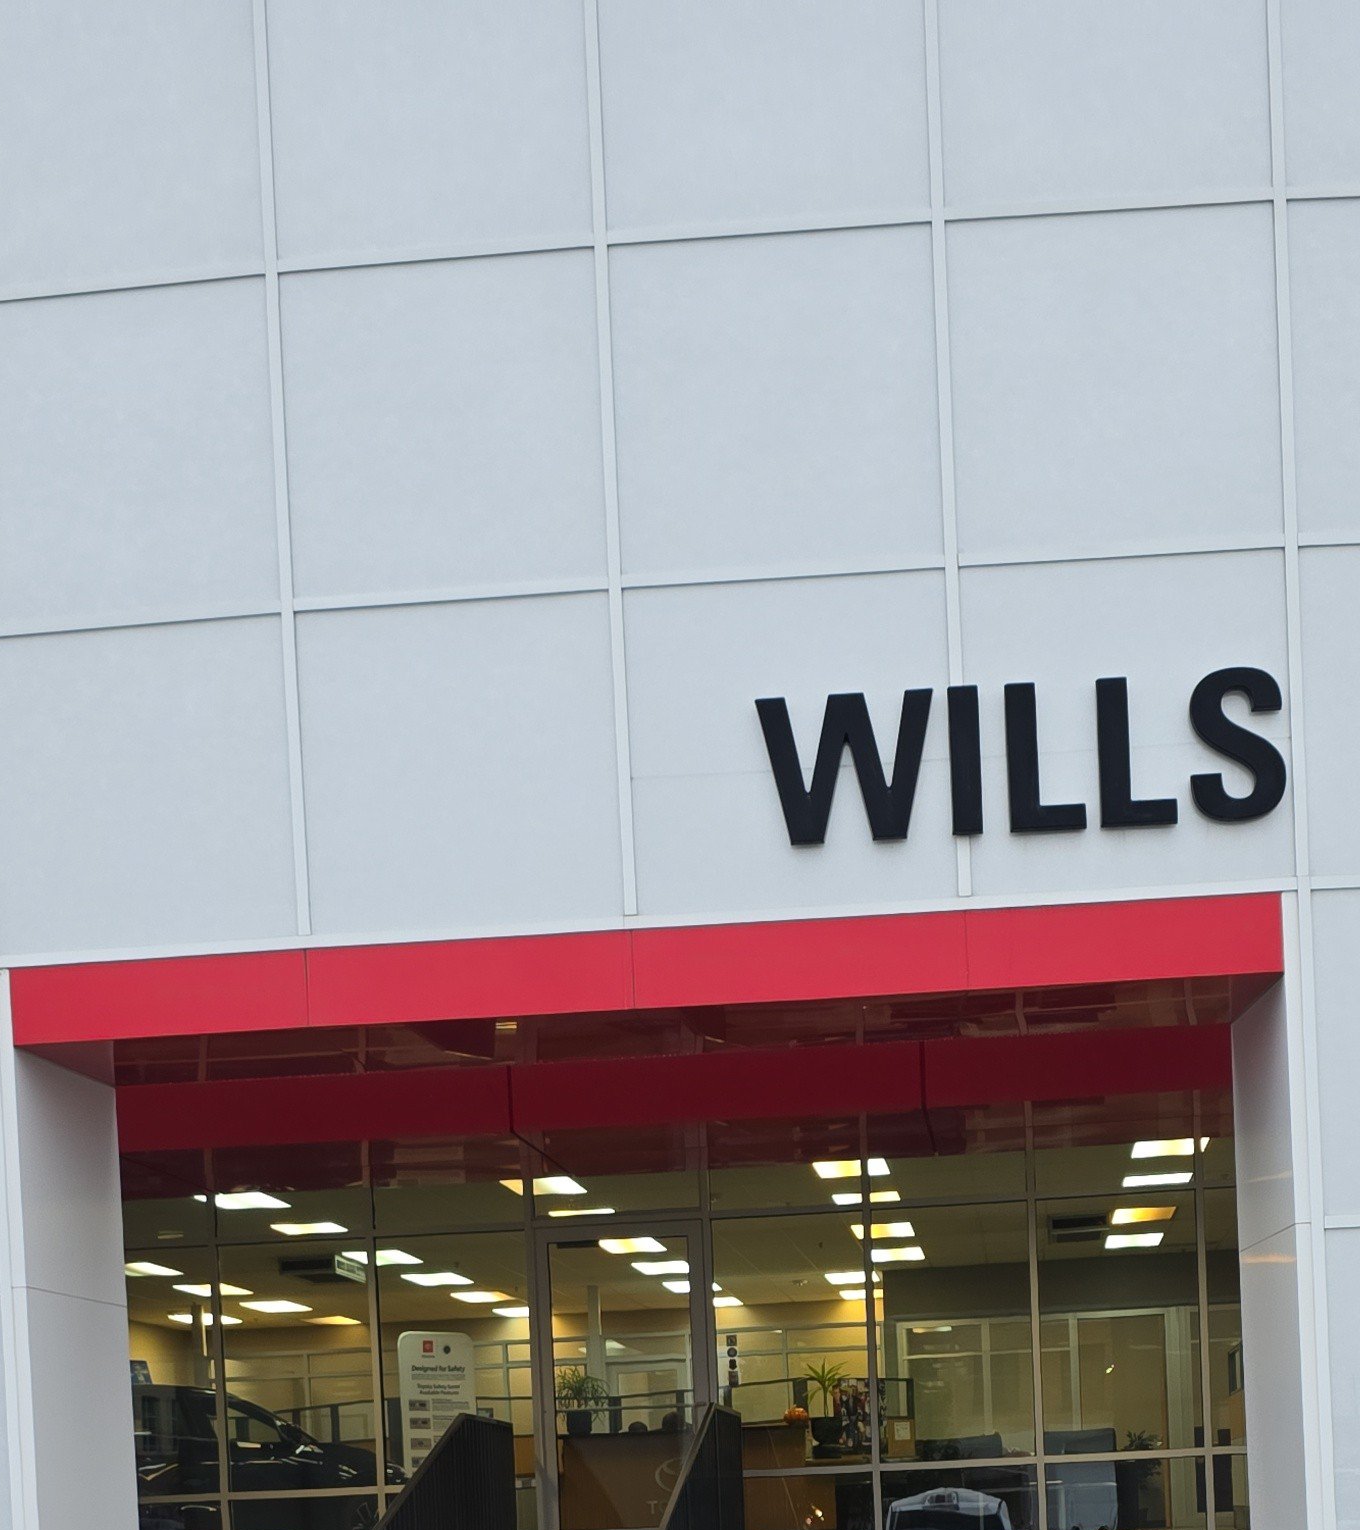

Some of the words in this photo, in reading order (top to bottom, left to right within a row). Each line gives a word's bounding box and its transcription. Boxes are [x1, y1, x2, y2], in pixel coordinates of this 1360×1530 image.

[755, 666, 1286, 845] WILLS
[411, 1365, 438, 1373] Designed
[448, 1365, 465, 1373] Safety
